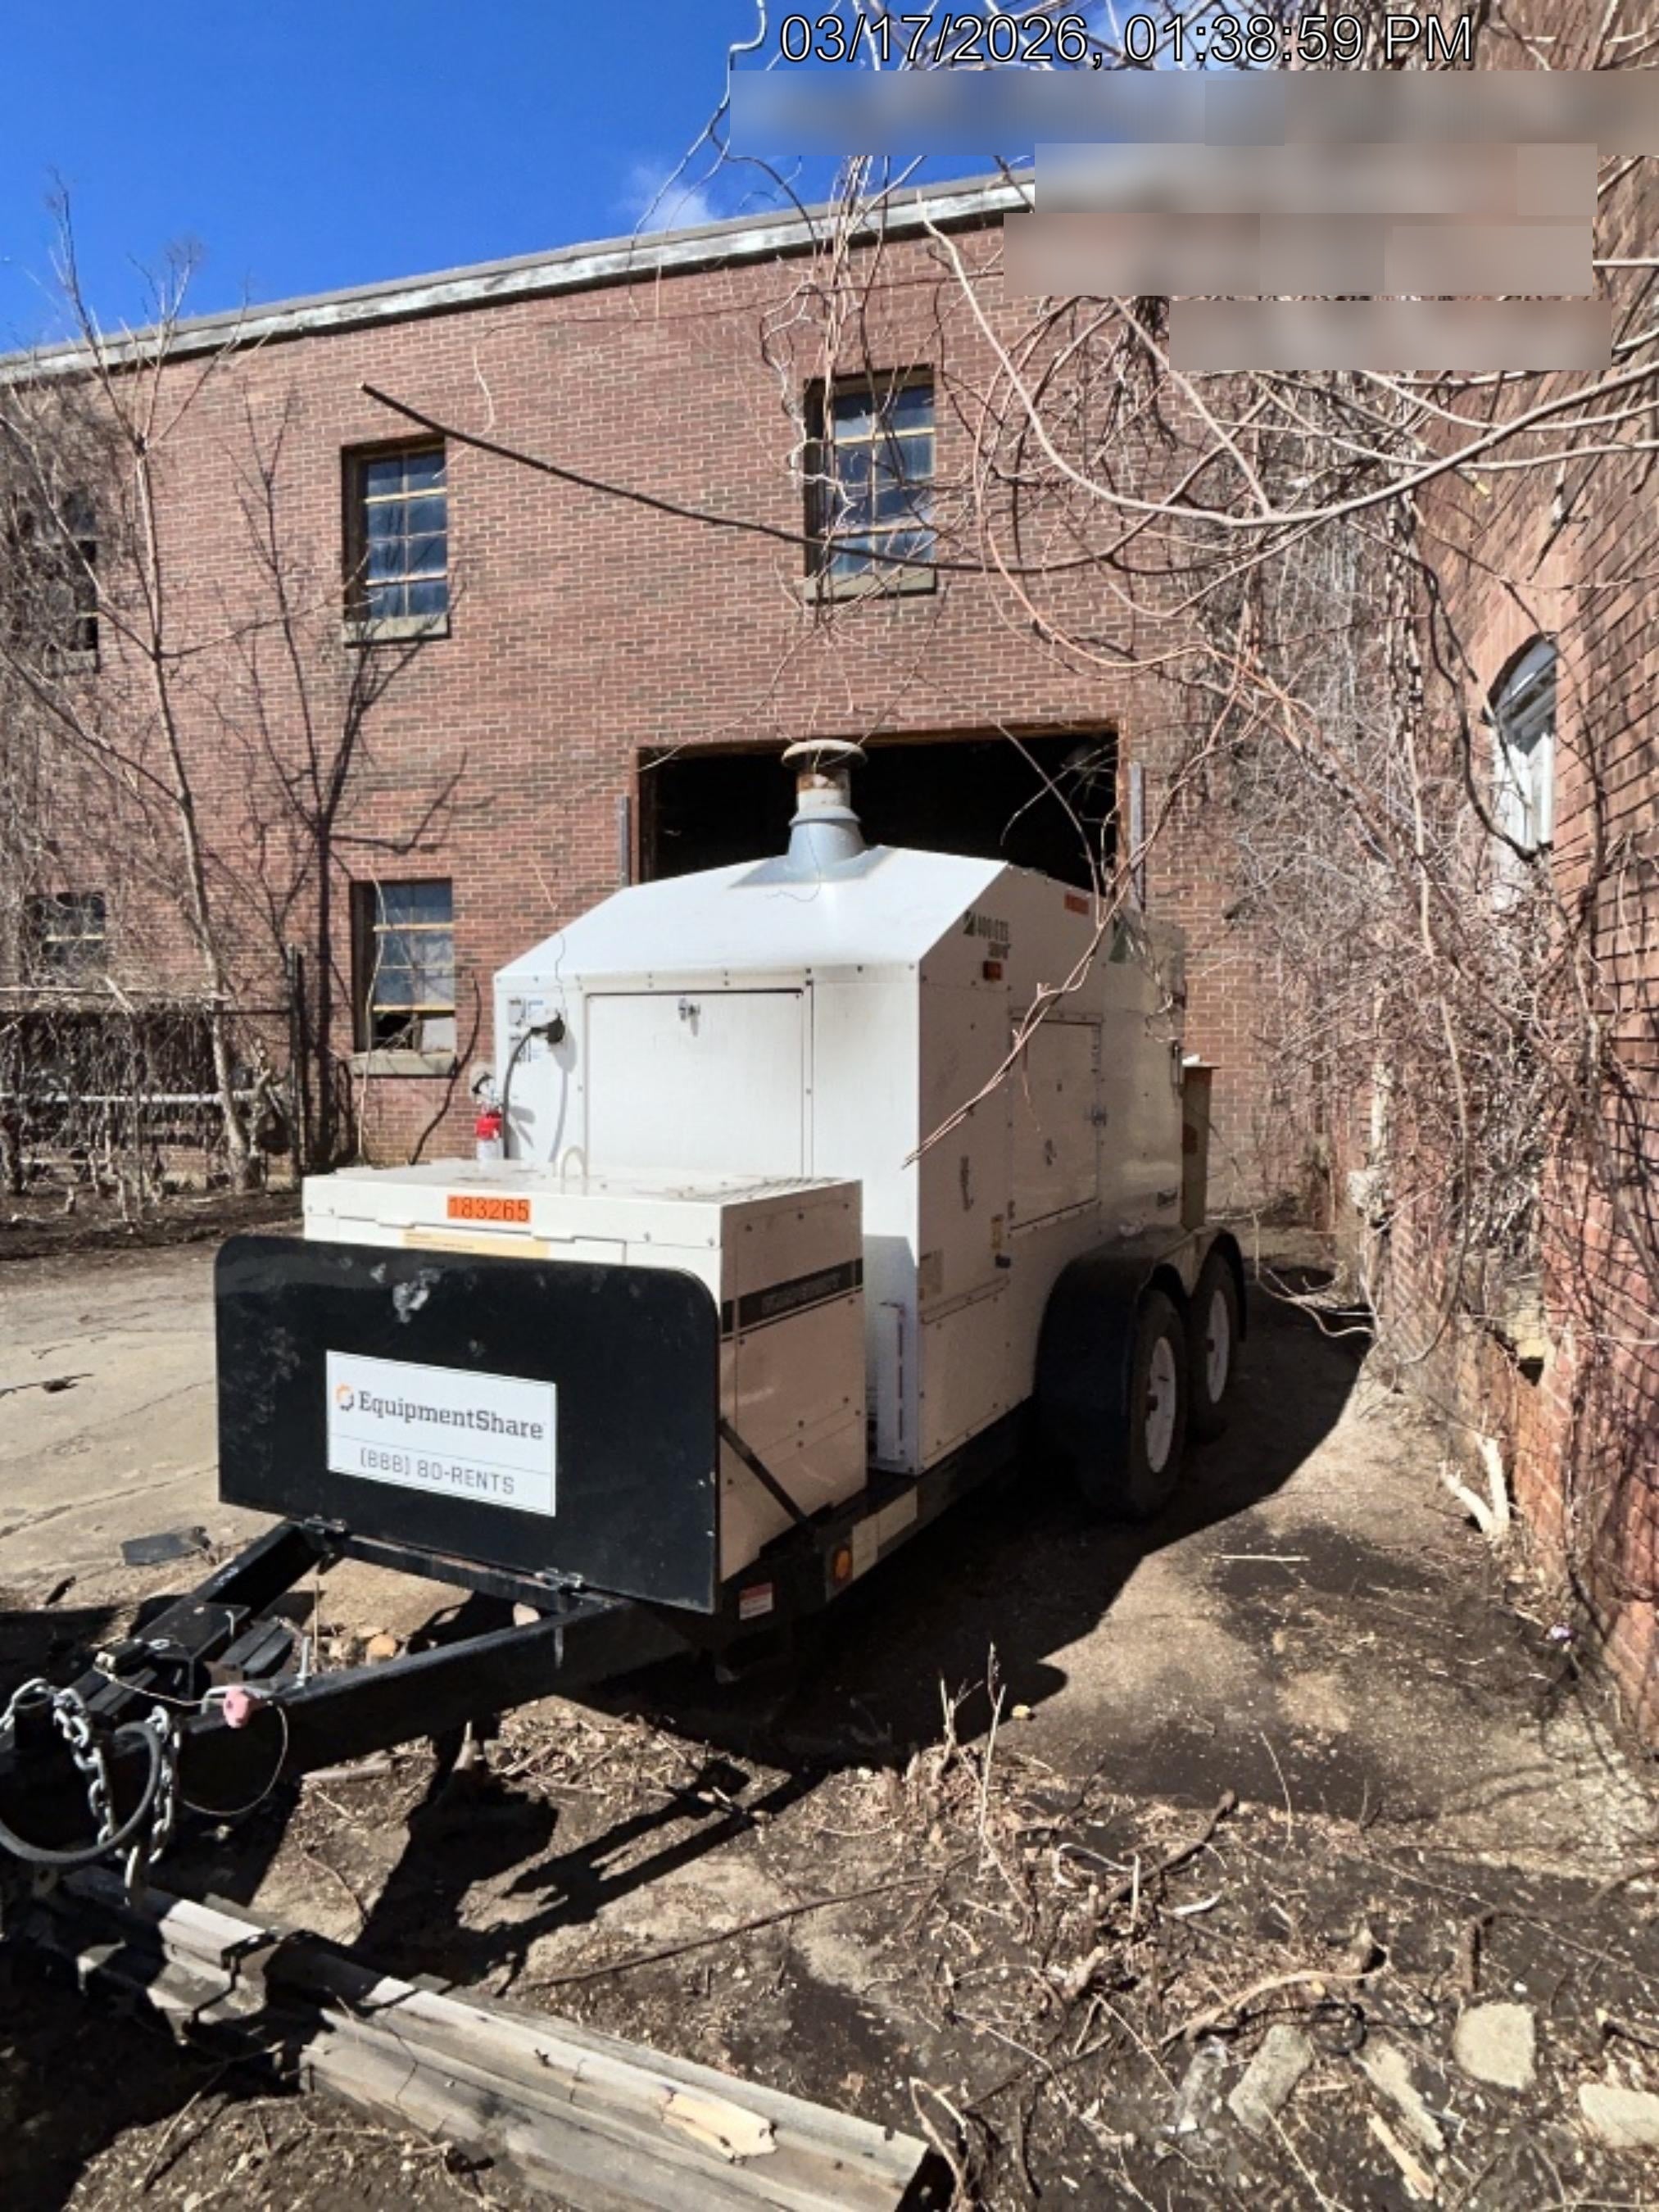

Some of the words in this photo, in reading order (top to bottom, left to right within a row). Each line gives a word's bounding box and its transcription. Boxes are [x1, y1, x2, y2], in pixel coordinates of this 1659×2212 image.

[449, 1196, 530, 1222] 183265
[358, 1391, 544, 1439] EquipmentShare
[360, 1448, 410, 1475] (888)
[416, 1459, 515, 1494] 80-RENTS
